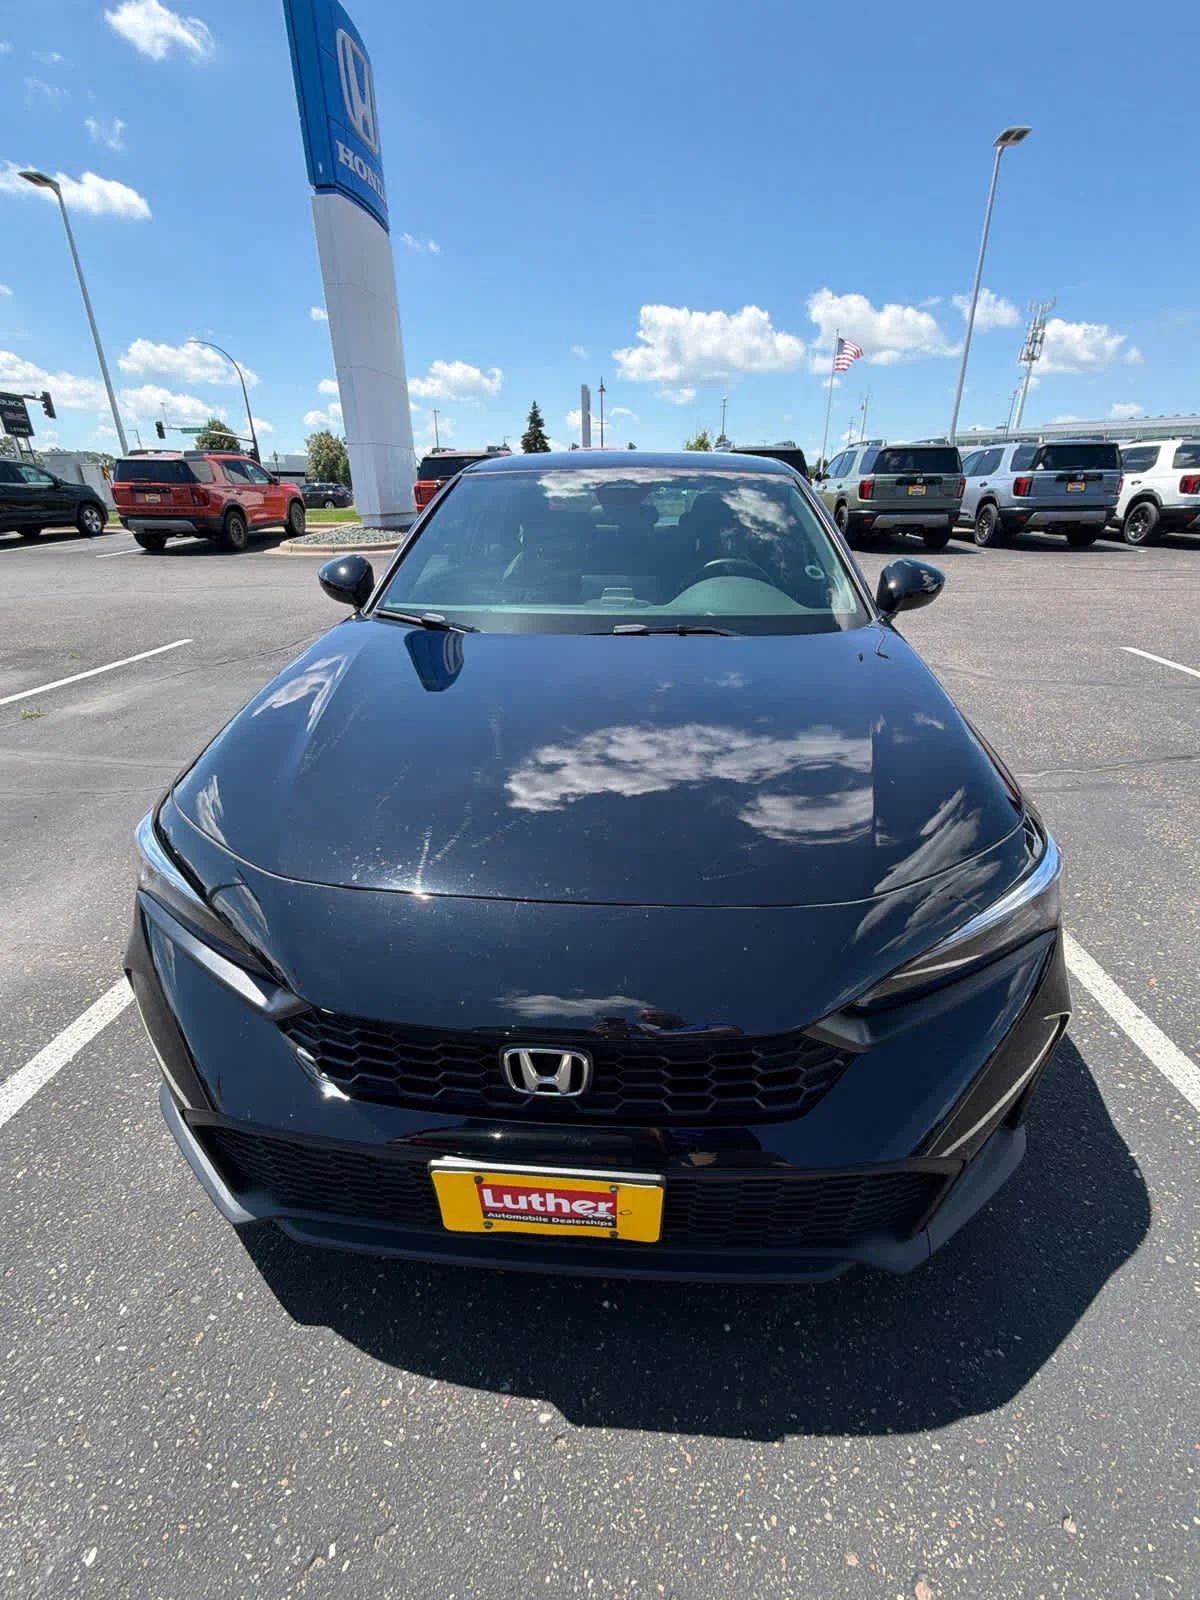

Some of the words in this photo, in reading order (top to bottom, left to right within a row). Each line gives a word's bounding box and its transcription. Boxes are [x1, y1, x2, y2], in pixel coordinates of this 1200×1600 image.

[482, 1188, 614, 1214] Luther
[487, 1212, 549, 1223] Automobile
[551, 1216, 613, 1227] Dealerships
